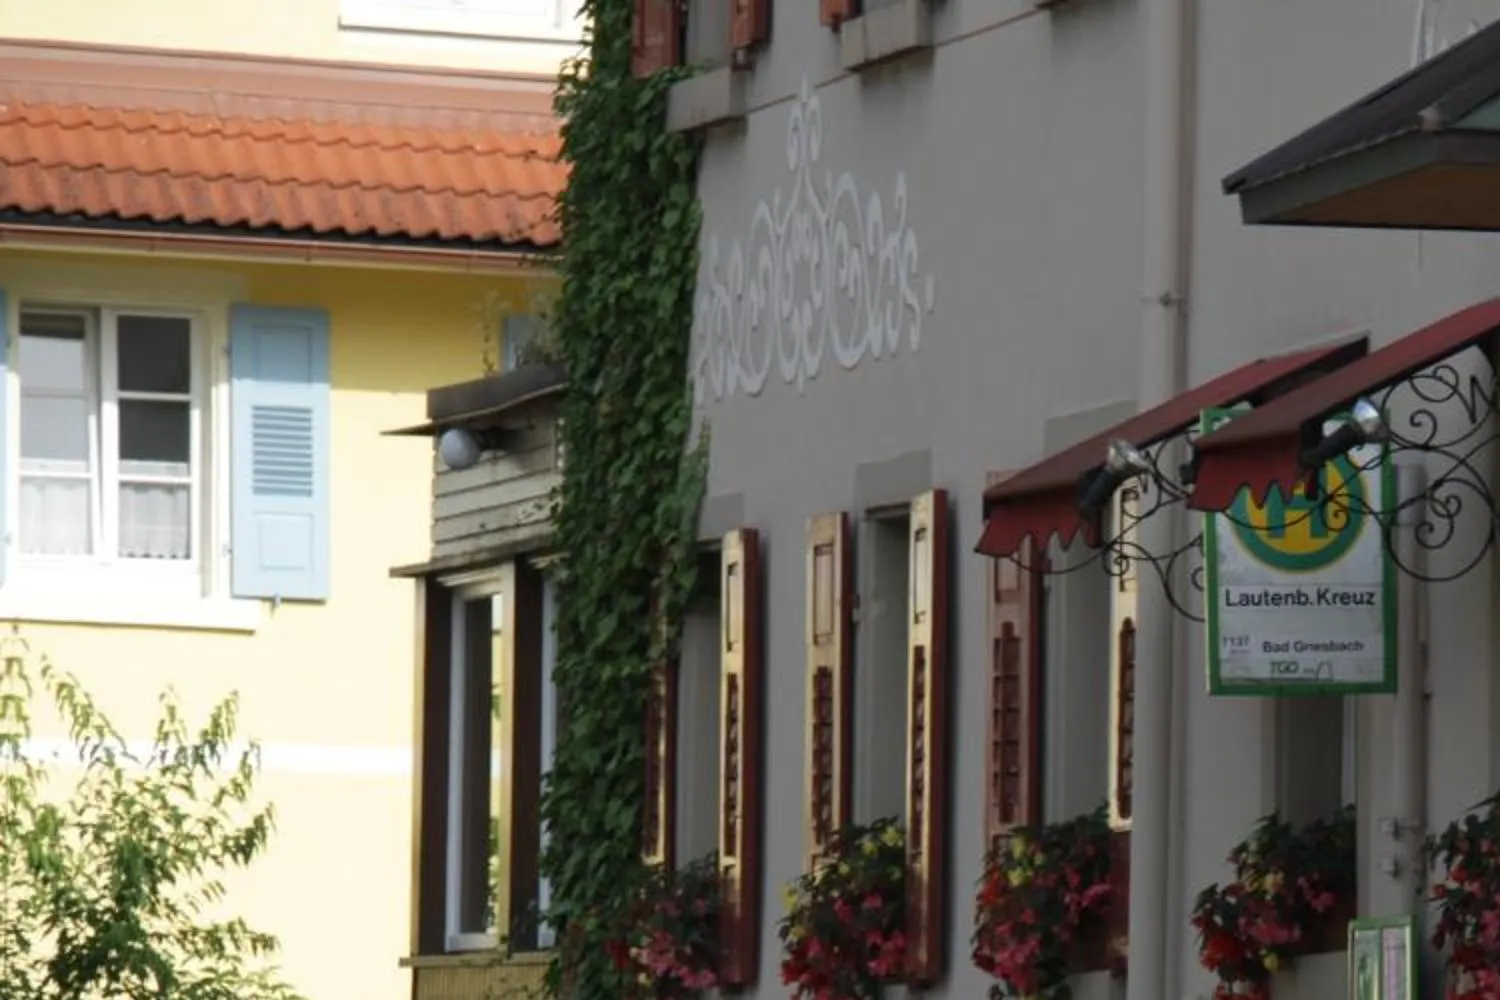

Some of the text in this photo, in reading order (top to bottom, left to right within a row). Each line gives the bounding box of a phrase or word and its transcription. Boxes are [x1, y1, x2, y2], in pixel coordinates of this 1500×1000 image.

[1225, 588, 1376, 608] Lautenb. Kreuz
[1262, 641, 1290, 653] Bad
